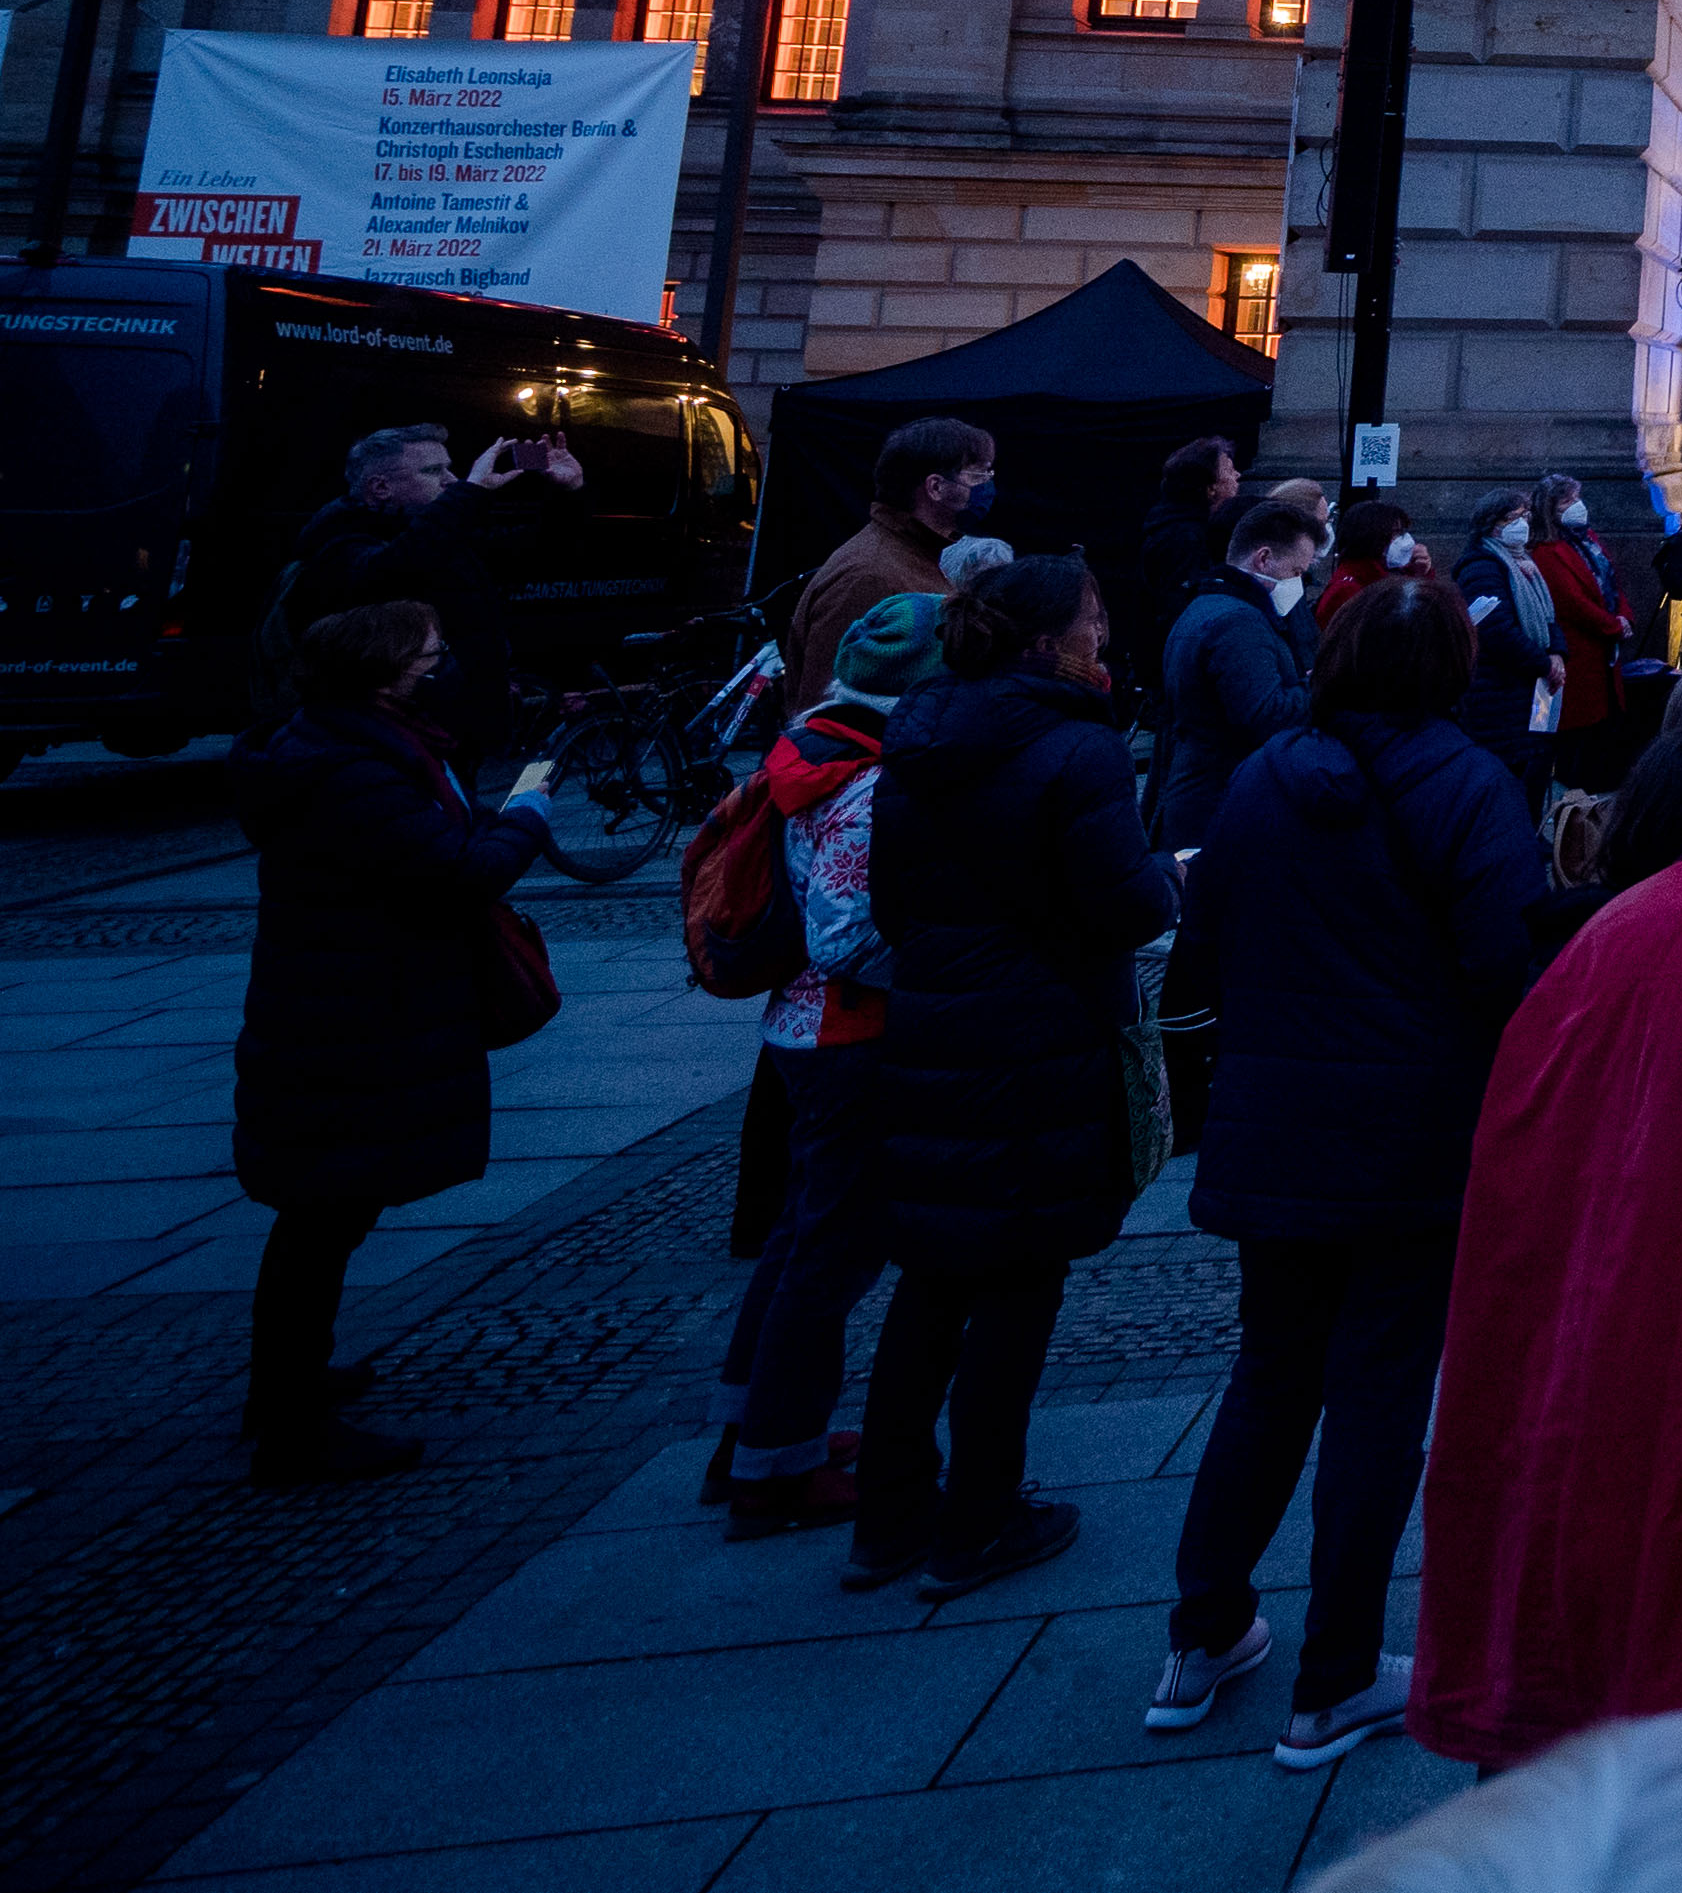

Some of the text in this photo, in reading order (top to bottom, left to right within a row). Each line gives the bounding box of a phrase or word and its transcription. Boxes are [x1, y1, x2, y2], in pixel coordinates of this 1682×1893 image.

[385, 65, 552, 89] Elisabeth Leonskaja
[382, 88, 503, 108] 15. März 2022
[379, 117, 638, 138] Konzerthausorchester Berlin &
[376, 140, 564, 162] Christoph Eschenbach
[158, 169, 258, 188] Ein Leben
[374, 164, 547, 183] 17. bis 19. März 2022
[370, 192, 529, 211] Antoine Tamestit &
[148, 197, 290, 235] ZWISCHEN
[365, 216, 530, 234] Alexander Melnikov
[362, 239, 482, 257] 21. März 2022
[460, 268, 531, 289] Bigband
[275, 320, 455, 356] www.lord-of-event.de
